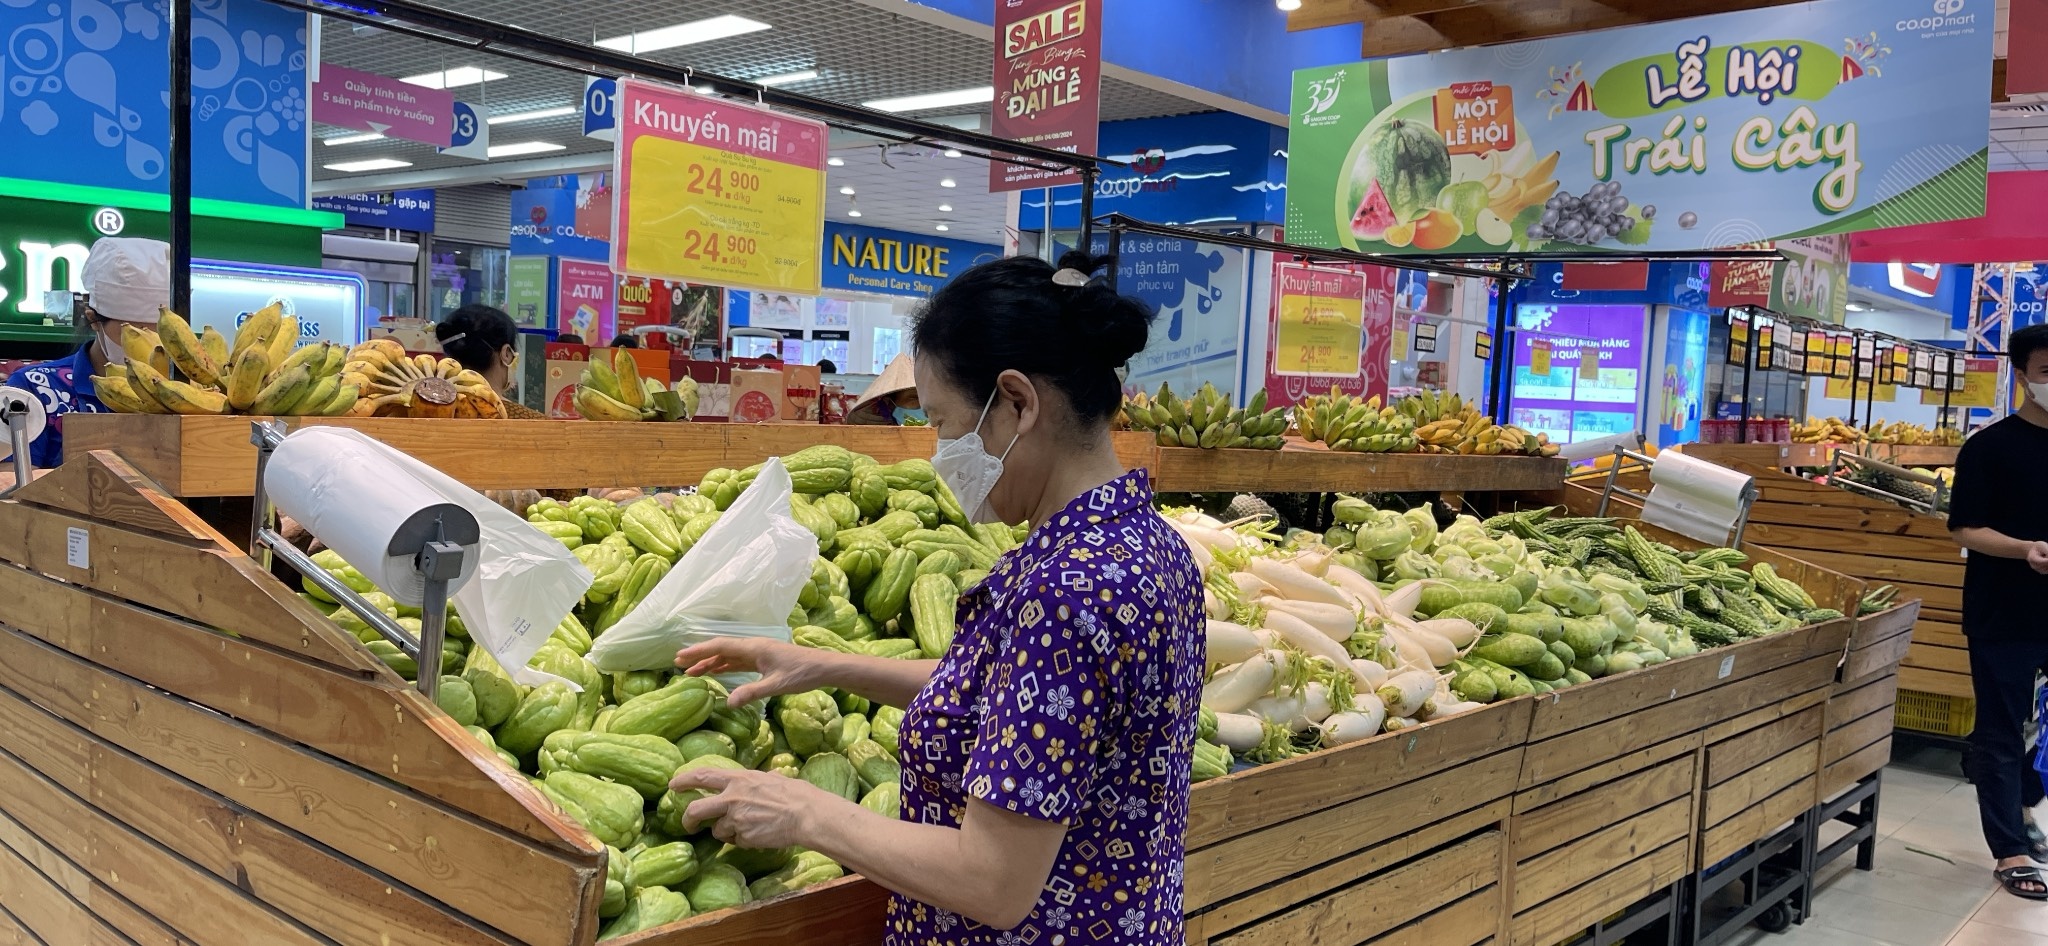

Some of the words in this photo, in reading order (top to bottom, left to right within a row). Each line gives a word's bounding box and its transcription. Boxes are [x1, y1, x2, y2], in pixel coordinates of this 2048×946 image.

[1009, 4, 1081, 54] SALE
[1645, 35, 1711, 108] Lễ
[1725, 45, 1802, 105] Hội
[345, 80, 372, 97] Quầy
[375, 87, 394, 99] tính
[397, 91, 416, 104] tiền
[1006, 88, 1047, 119] ĐẠI
[1053, 66, 1081, 107] LỄ
[323, 92, 330, 101] 5
[332, 93, 352, 107] sản
[354, 99, 384, 113] phẩm
[385, 105, 401, 117] trở
[403, 107, 435, 126] xuống
[1454, 96, 1498, 121] MỘT
[634, 99, 730, 142] Khuyến
[738, 126, 778, 153] mãi
[1445, 120, 1467, 146] LỄ
[1471, 120, 1508, 146] HỘI
[1585, 114, 1708, 182] Trái
[1731, 105, 1865, 216] Cây
[398, 198, 417, 209] gặp
[419, 199, 430, 211] lại
[832, 233, 950, 278] NATURE
[1127, 241, 1136, 254] &
[1139, 240, 1153, 253] sẻ
[1156, 239, 1182, 253] chia
[1135, 261, 1154, 276] tận
[1156, 260, 1179, 274] tâm
[572, 283, 603, 300] ATM
[848, 272, 888, 289] Personal
[890, 278, 910, 291] Care
[913, 281, 933, 295] Shop
[1137, 280, 1160, 293] phục
[1162, 281, 1174, 292] vụ
[1282, 275, 1324, 295] Khuyến
[1324, 279, 1342, 294] mãi
[1166, 347, 1191, 362] trang
